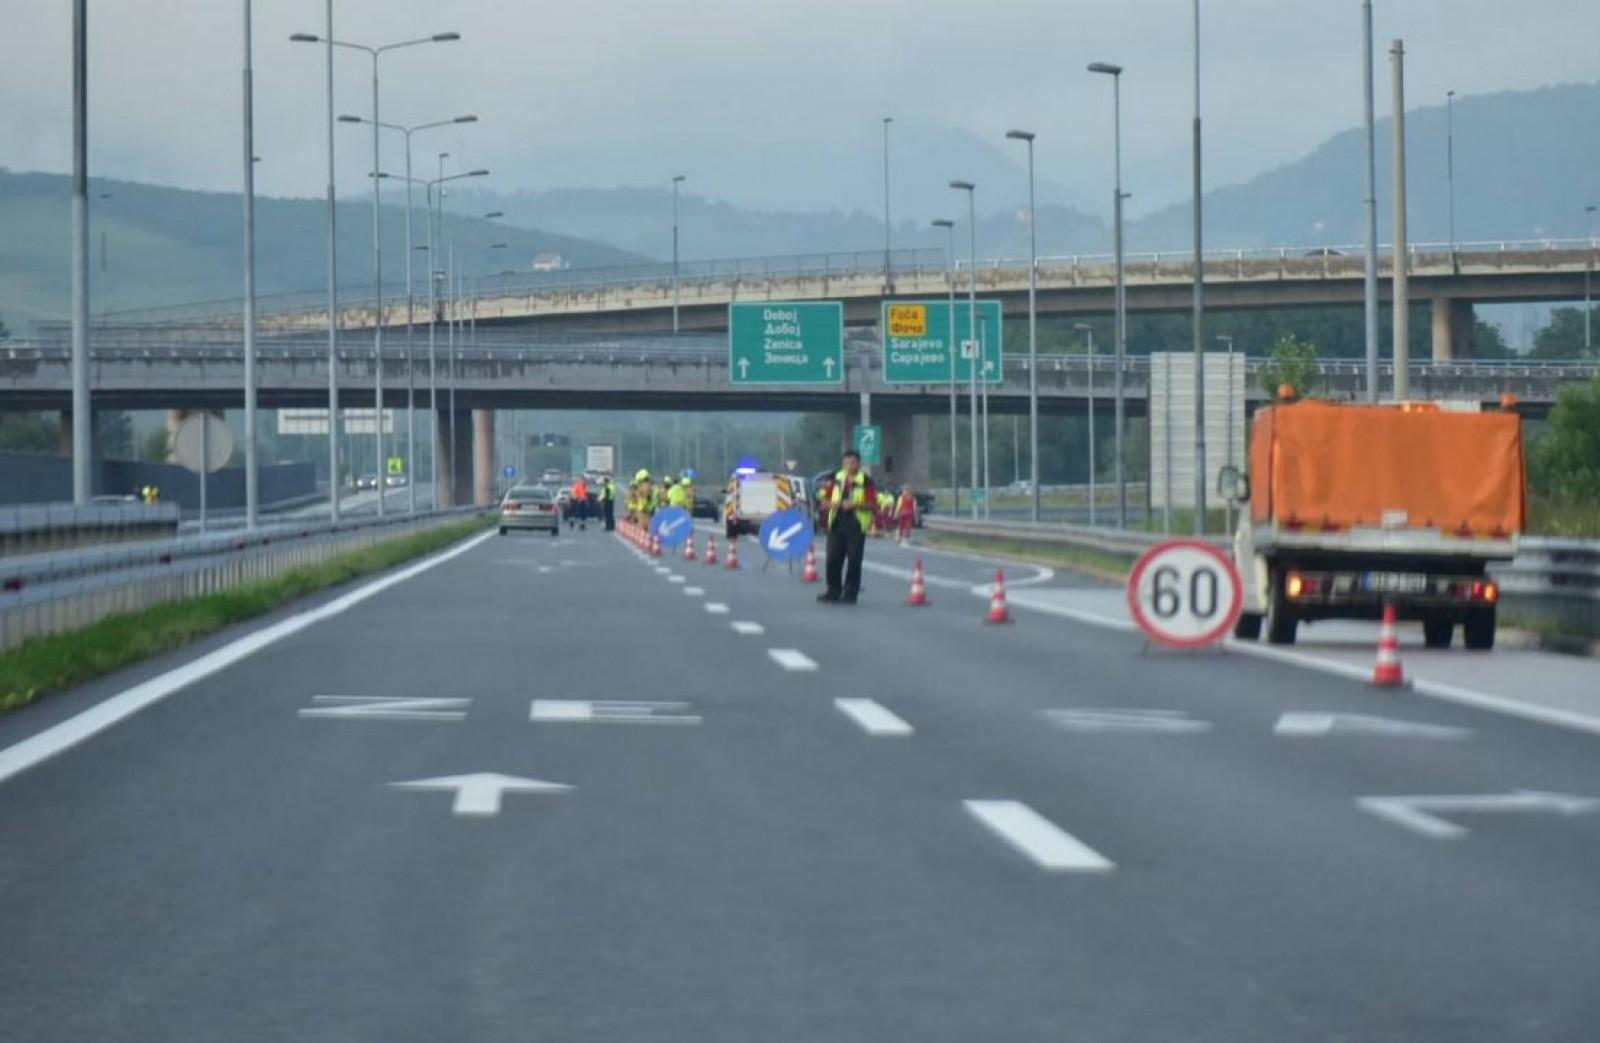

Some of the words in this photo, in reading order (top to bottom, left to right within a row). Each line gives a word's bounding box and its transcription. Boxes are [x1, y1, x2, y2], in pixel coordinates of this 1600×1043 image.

[763, 308, 798, 322] Doboj
[763, 338, 803, 350] Zenica
[890, 338, 943, 351] Sarajevo
[1152, 565, 1217, 619] 60
